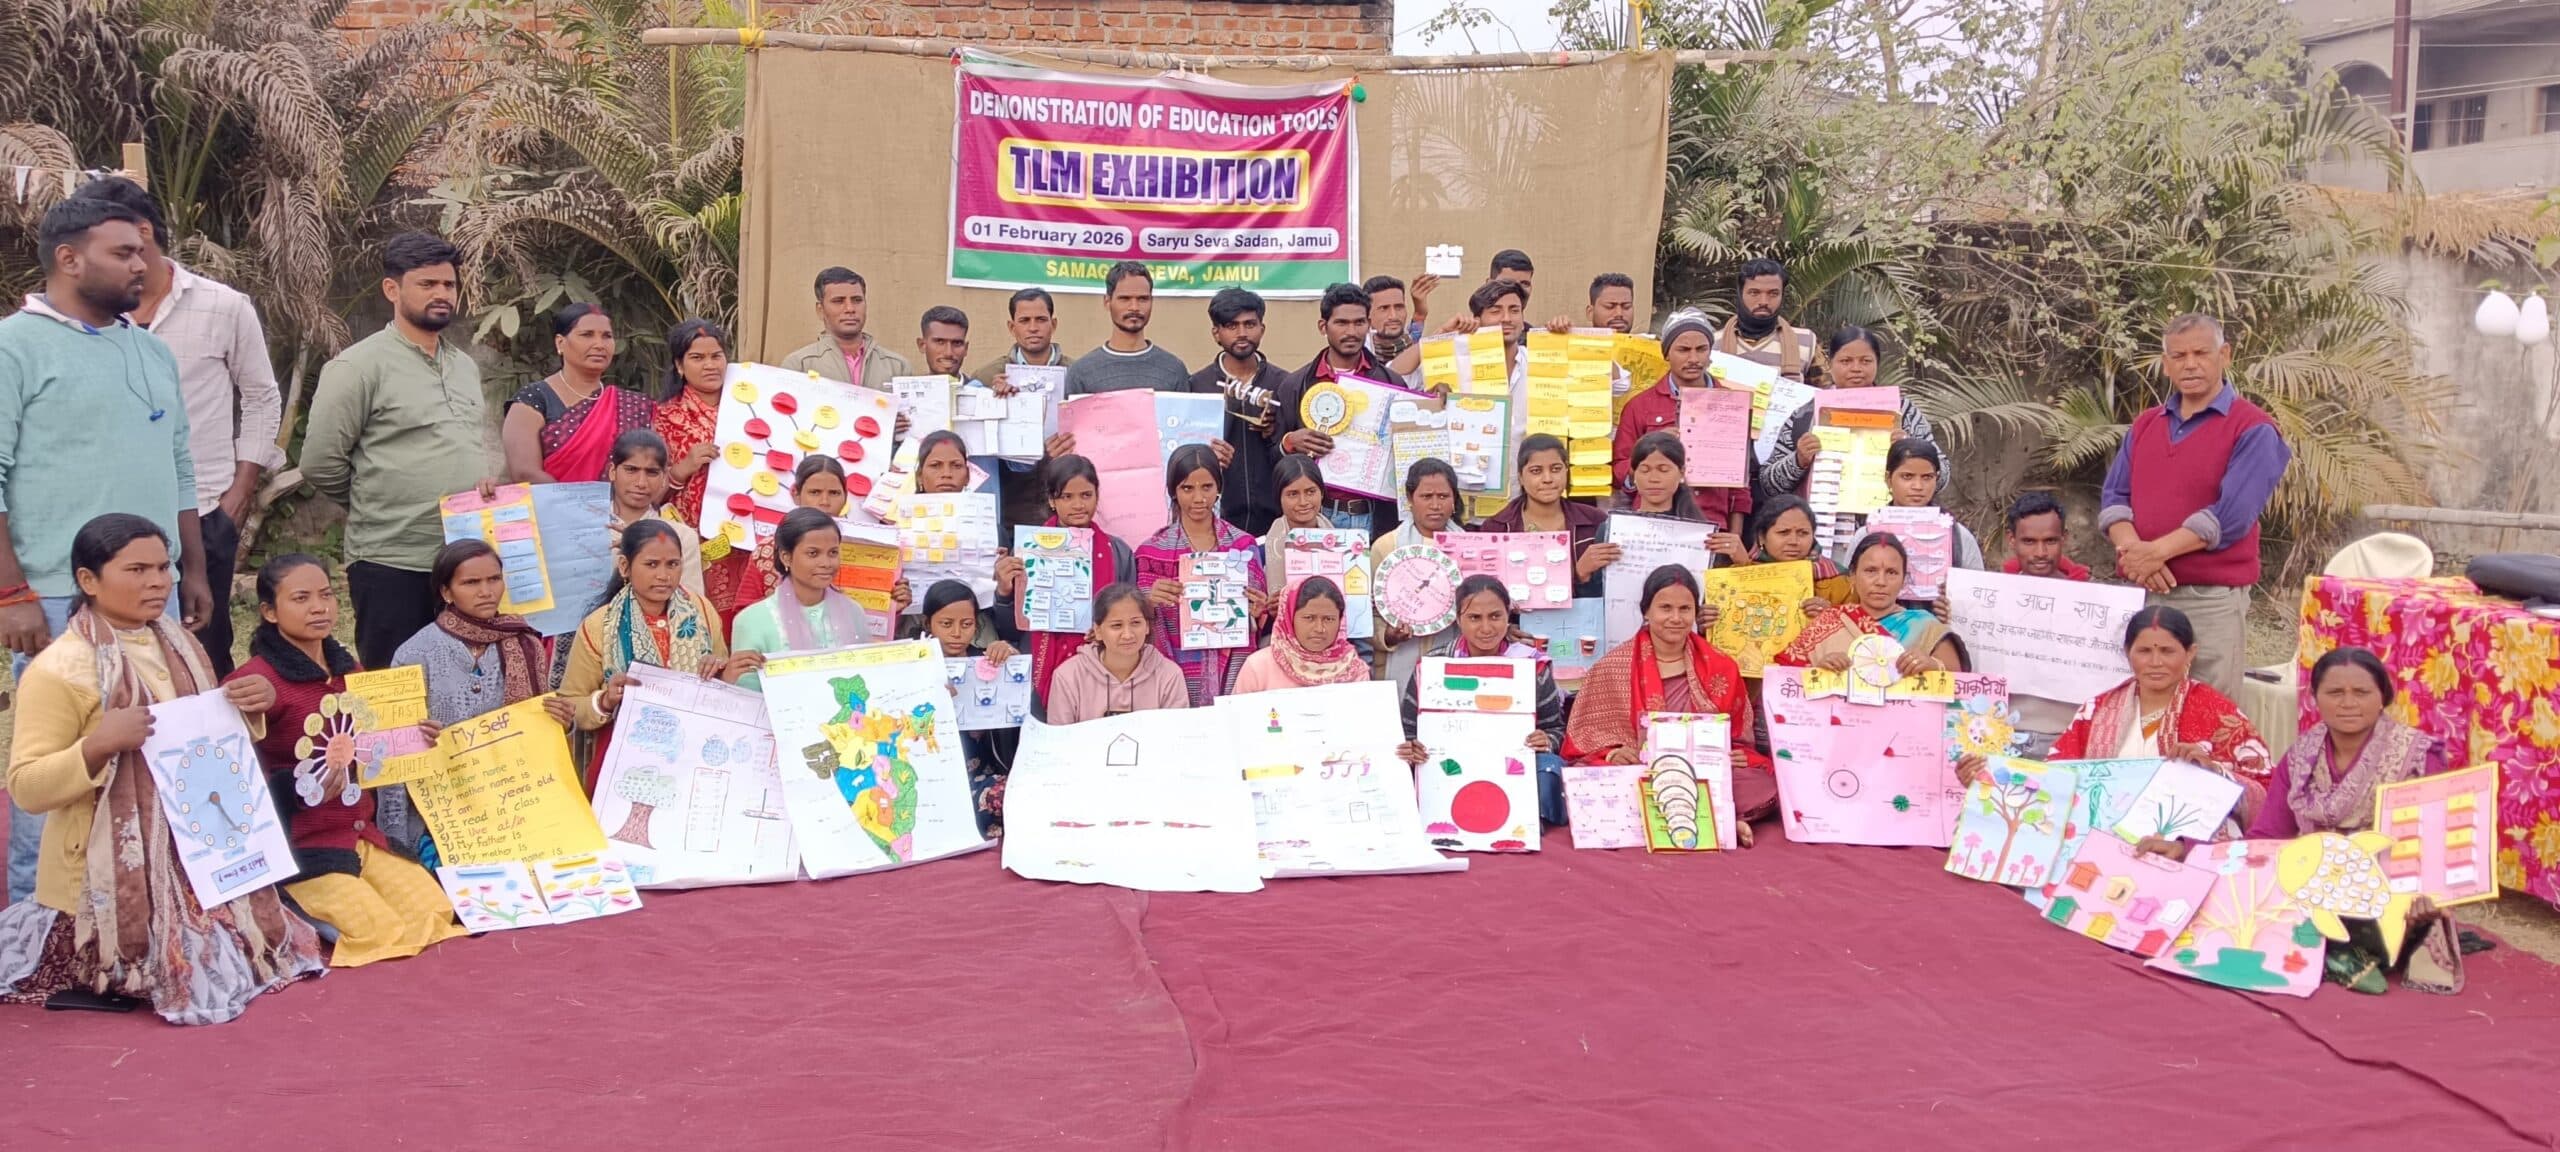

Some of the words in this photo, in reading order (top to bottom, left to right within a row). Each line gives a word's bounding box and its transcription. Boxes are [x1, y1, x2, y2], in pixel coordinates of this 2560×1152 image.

[970, 90, 1132, 129] DEMONSTRATION
[1138, 103, 1163, 130] OF
[1169, 107, 1276, 137] EDUCATION
[1281, 107, 1339, 133] TOOLS
[1009, 146, 1086, 199] TLM
[1091, 152, 1301, 205] EXHIBITION
[971, 222, 992, 238] 01
[999, 224, 1077, 246] February
[1083, 230, 1124, 246] 2026
[1147, 233, 1189, 251] Saryu
[1194, 234, 1229, 248] Seva
[1234, 234, 1283, 251] Sadan,
[1288, 234, 1333, 248] Jamui
[1046, 260, 1110, 279] SAMAG
[1202, 266, 1260, 281] JAMUI
[451, 727, 476, 747] My
[479, 711, 510, 735] Self
[433, 782, 448, 794] My
[482, 764, 507, 776] name
[437, 795, 452, 807] My
[456, 786, 485, 800] mother
[490, 775, 516, 789] name
[442, 808, 453, 818] I
[458, 804, 473, 815] am
[498, 784, 532, 805] years
[537, 772, 556, 787] old
[447, 819, 459, 829] I
[463, 809, 489, 826] read
[452, 830, 464, 840] I
[457, 839, 473, 850] My
[477, 834, 506, 848] father
[448, 853, 459, 865] 8)
[462, 851, 476, 864] My
